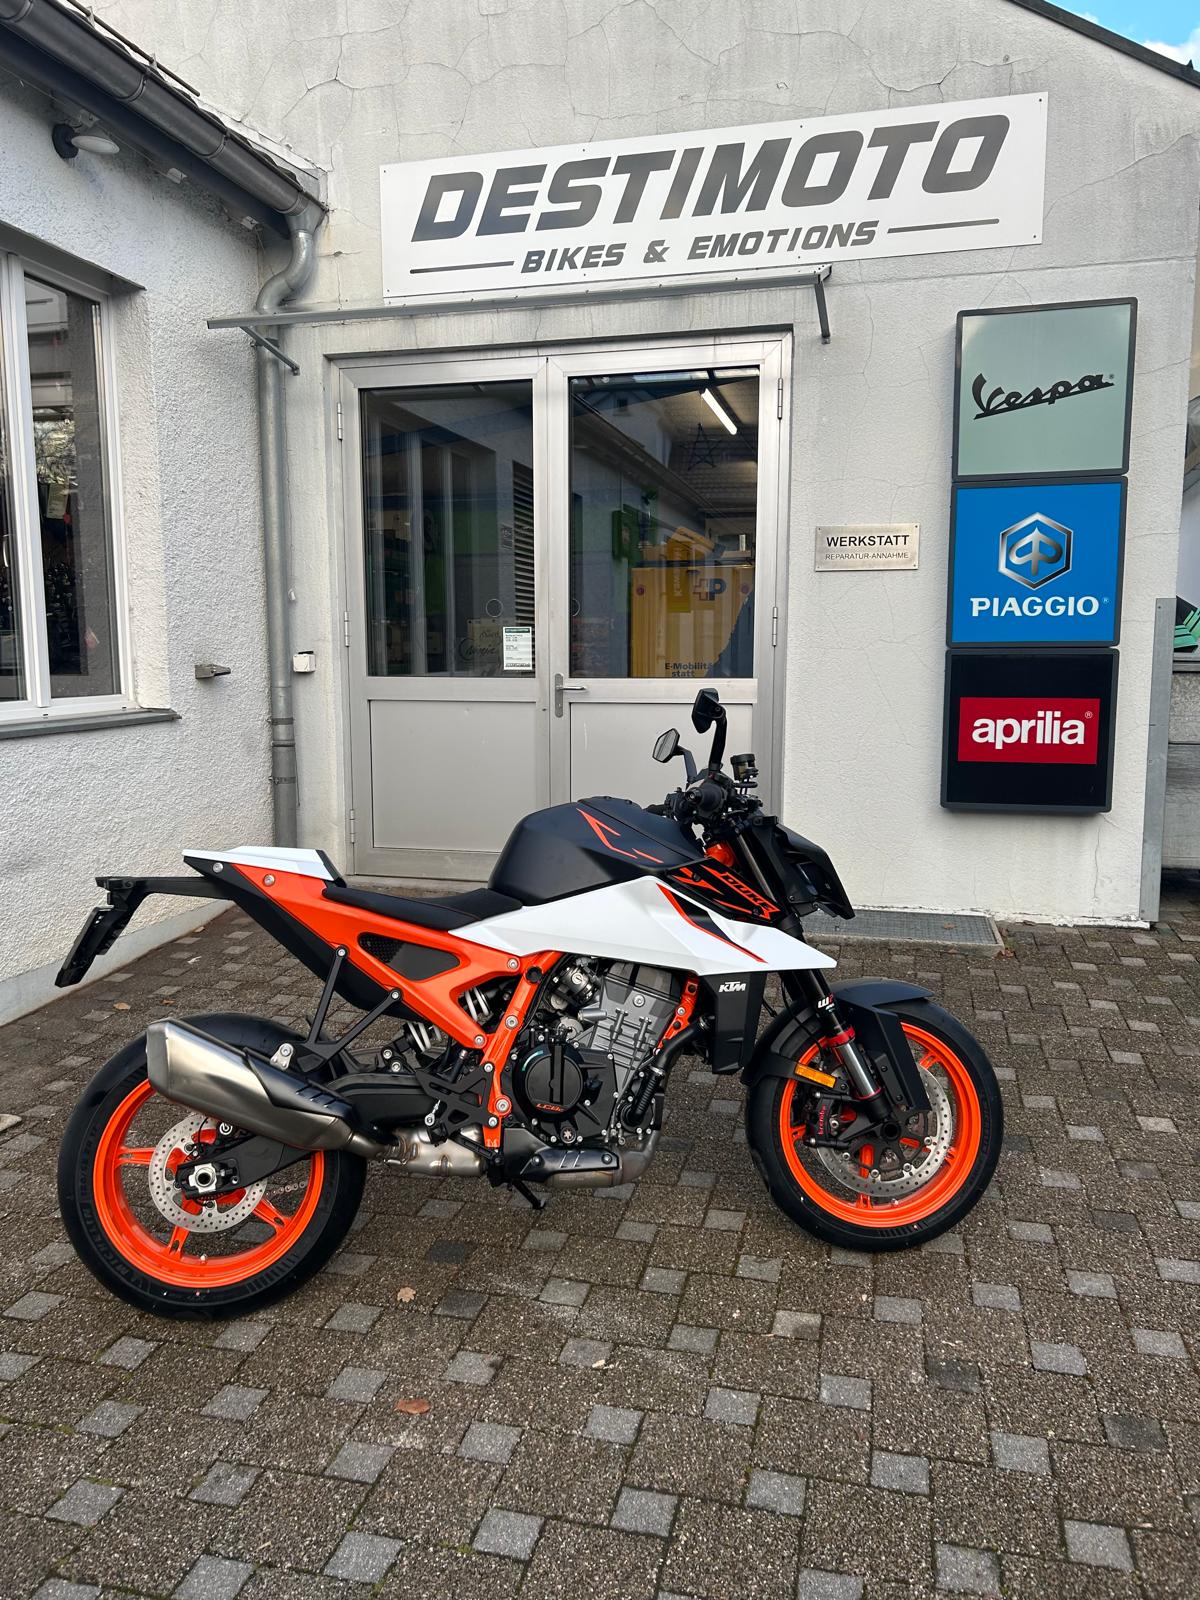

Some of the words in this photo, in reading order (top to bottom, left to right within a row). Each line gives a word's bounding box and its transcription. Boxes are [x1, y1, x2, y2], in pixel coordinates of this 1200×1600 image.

[411, 114, 1010, 242] DESTIMOTO
[521, 243, 627, 273] BIKES
[643, 239, 670, 264] &
[687, 220, 879, 260] EMOTIONS
[972, 373, 1115, 420] Vespa
[826, 535, 909, 547] WERKSTATT
[825, 552, 909, 560] REPARATUR-ANNAHME
[970, 596, 1100, 617] PIAGGIO
[971, 711, 1085, 749] aprilia
[719, 982, 746, 992] KTM
